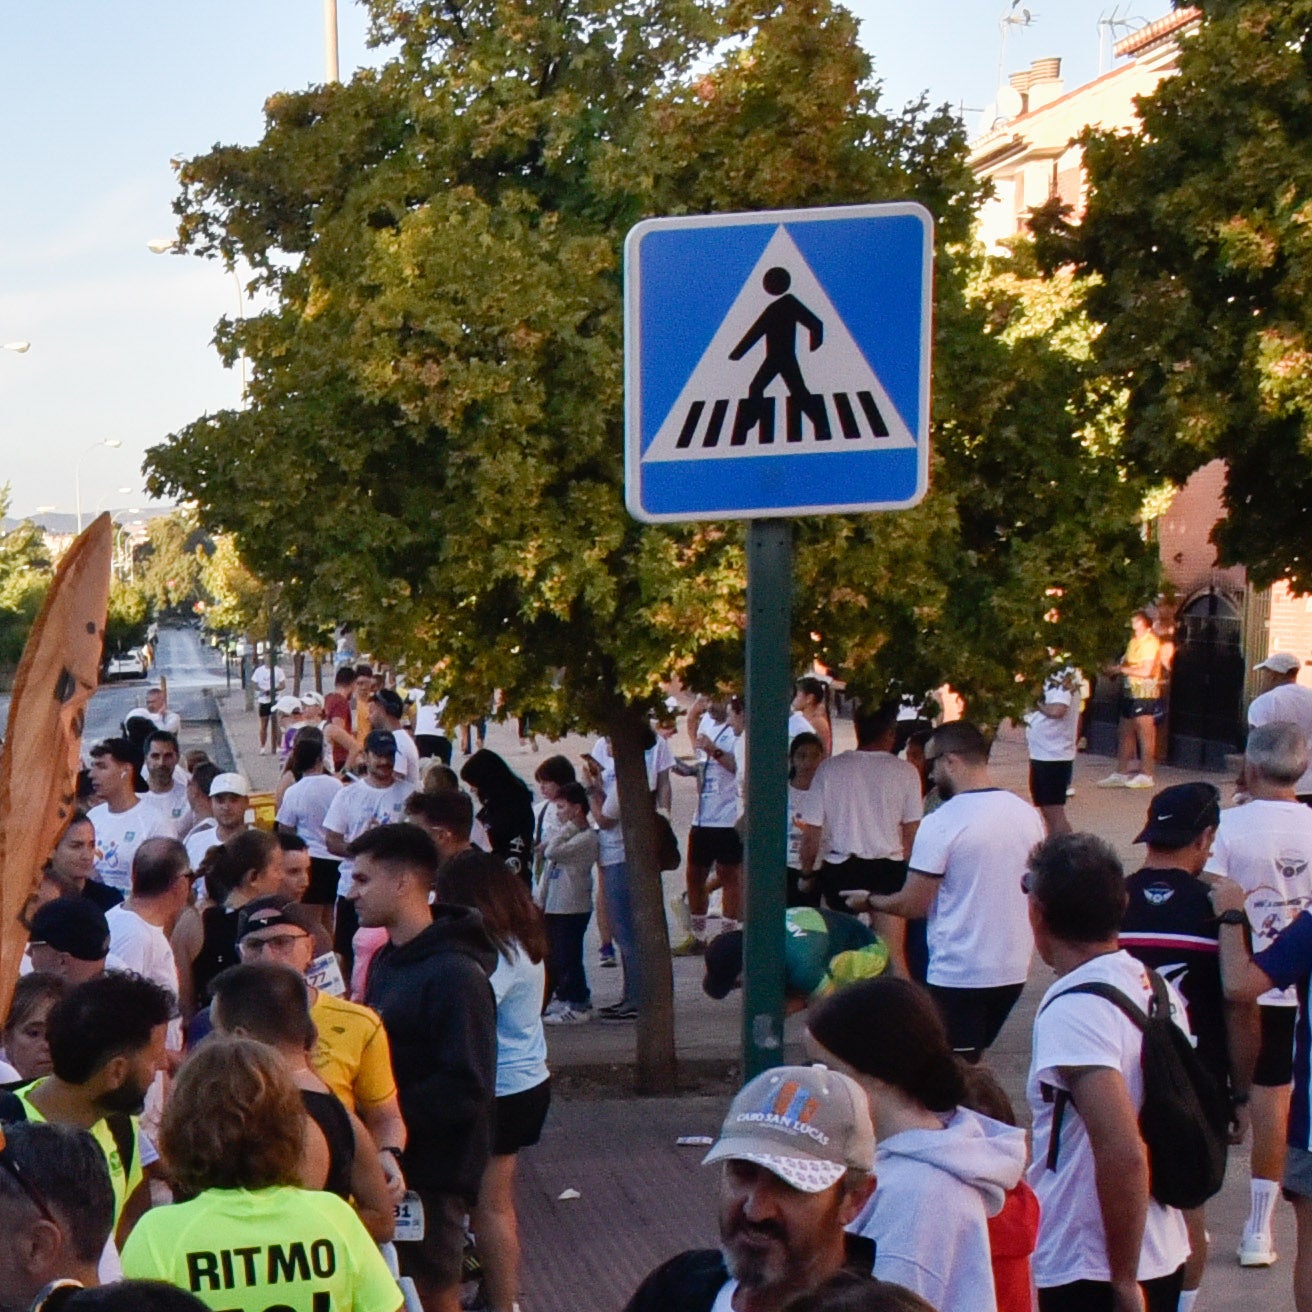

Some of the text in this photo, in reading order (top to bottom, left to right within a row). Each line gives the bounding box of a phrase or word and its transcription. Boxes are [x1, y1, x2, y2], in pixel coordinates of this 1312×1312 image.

[764, 1113, 793, 1127] SAN
[793, 1120, 830, 1147] LUCAS
[187, 1239, 336, 1292] RITMO
